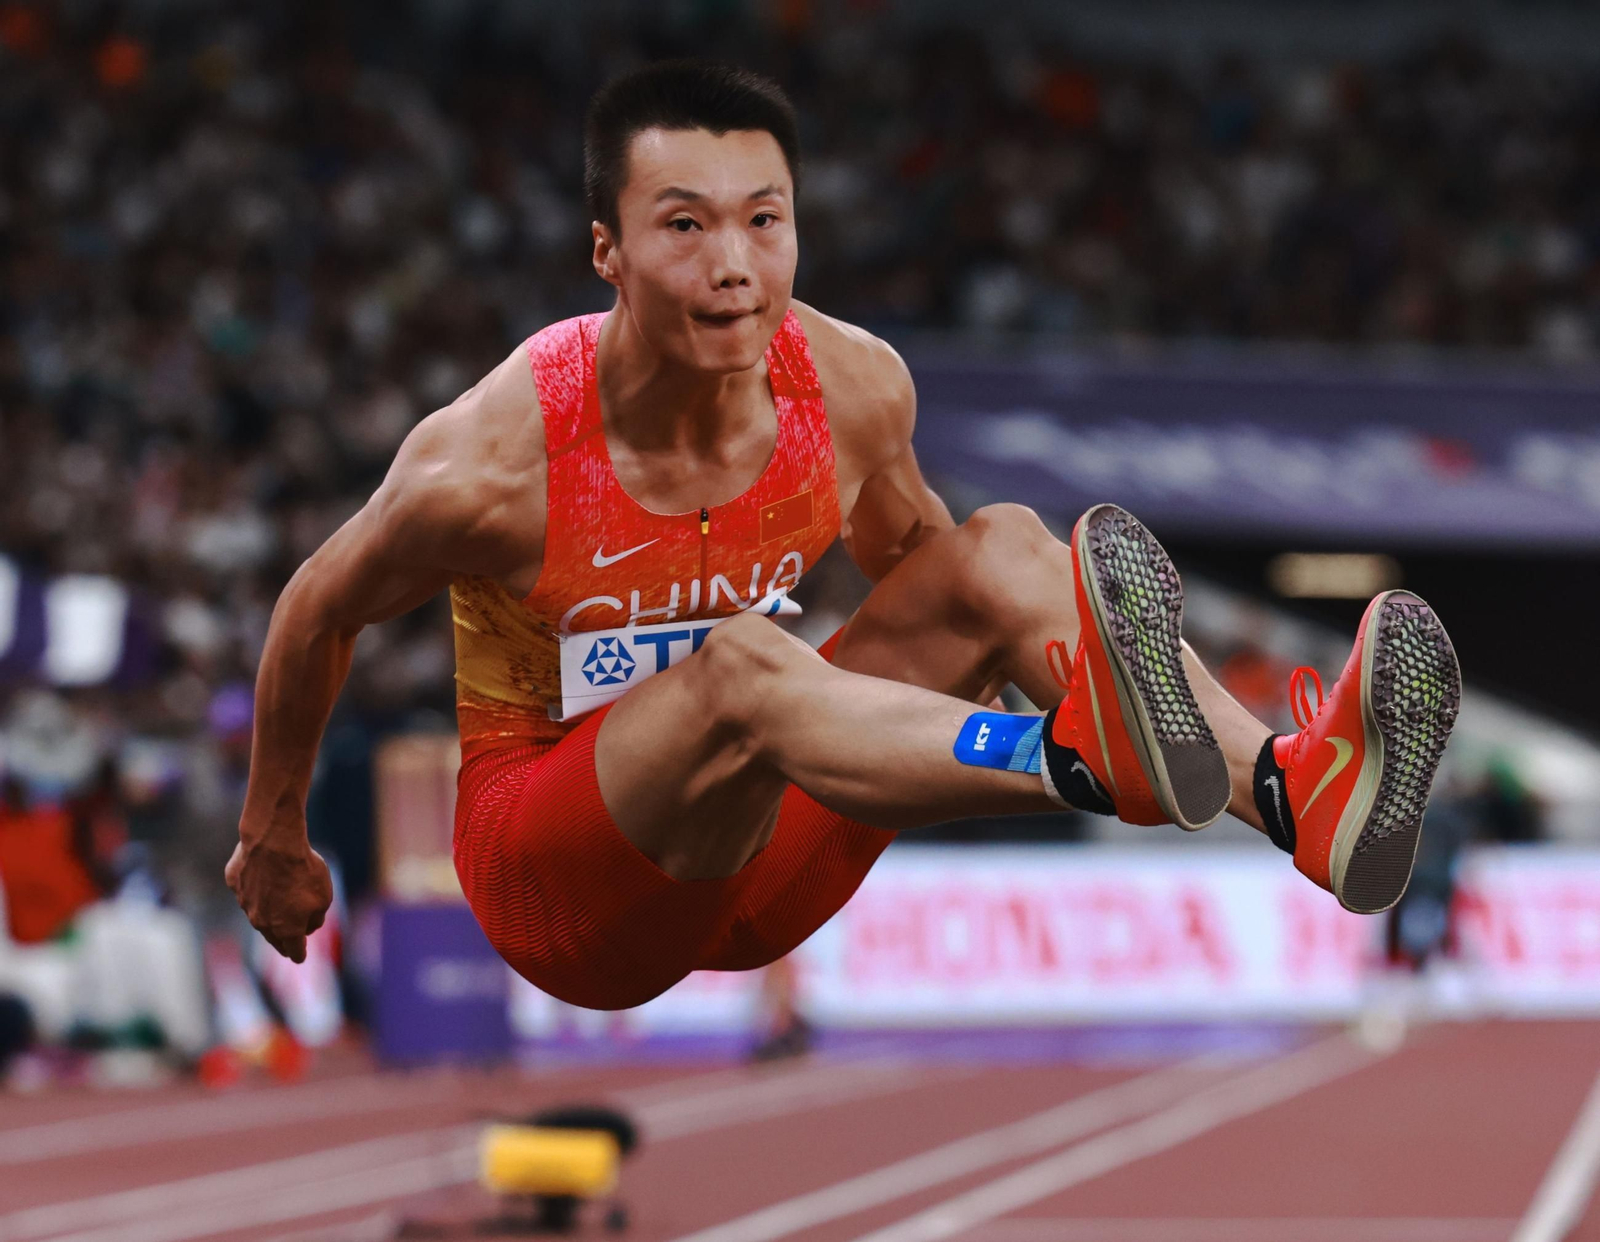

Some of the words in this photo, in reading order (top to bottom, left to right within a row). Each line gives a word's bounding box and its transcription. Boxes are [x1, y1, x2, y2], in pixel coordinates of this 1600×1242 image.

[558, 551, 804, 635] CHINA
[973, 722, 991, 751] KT
[845, 886, 1236, 980] HONDA
